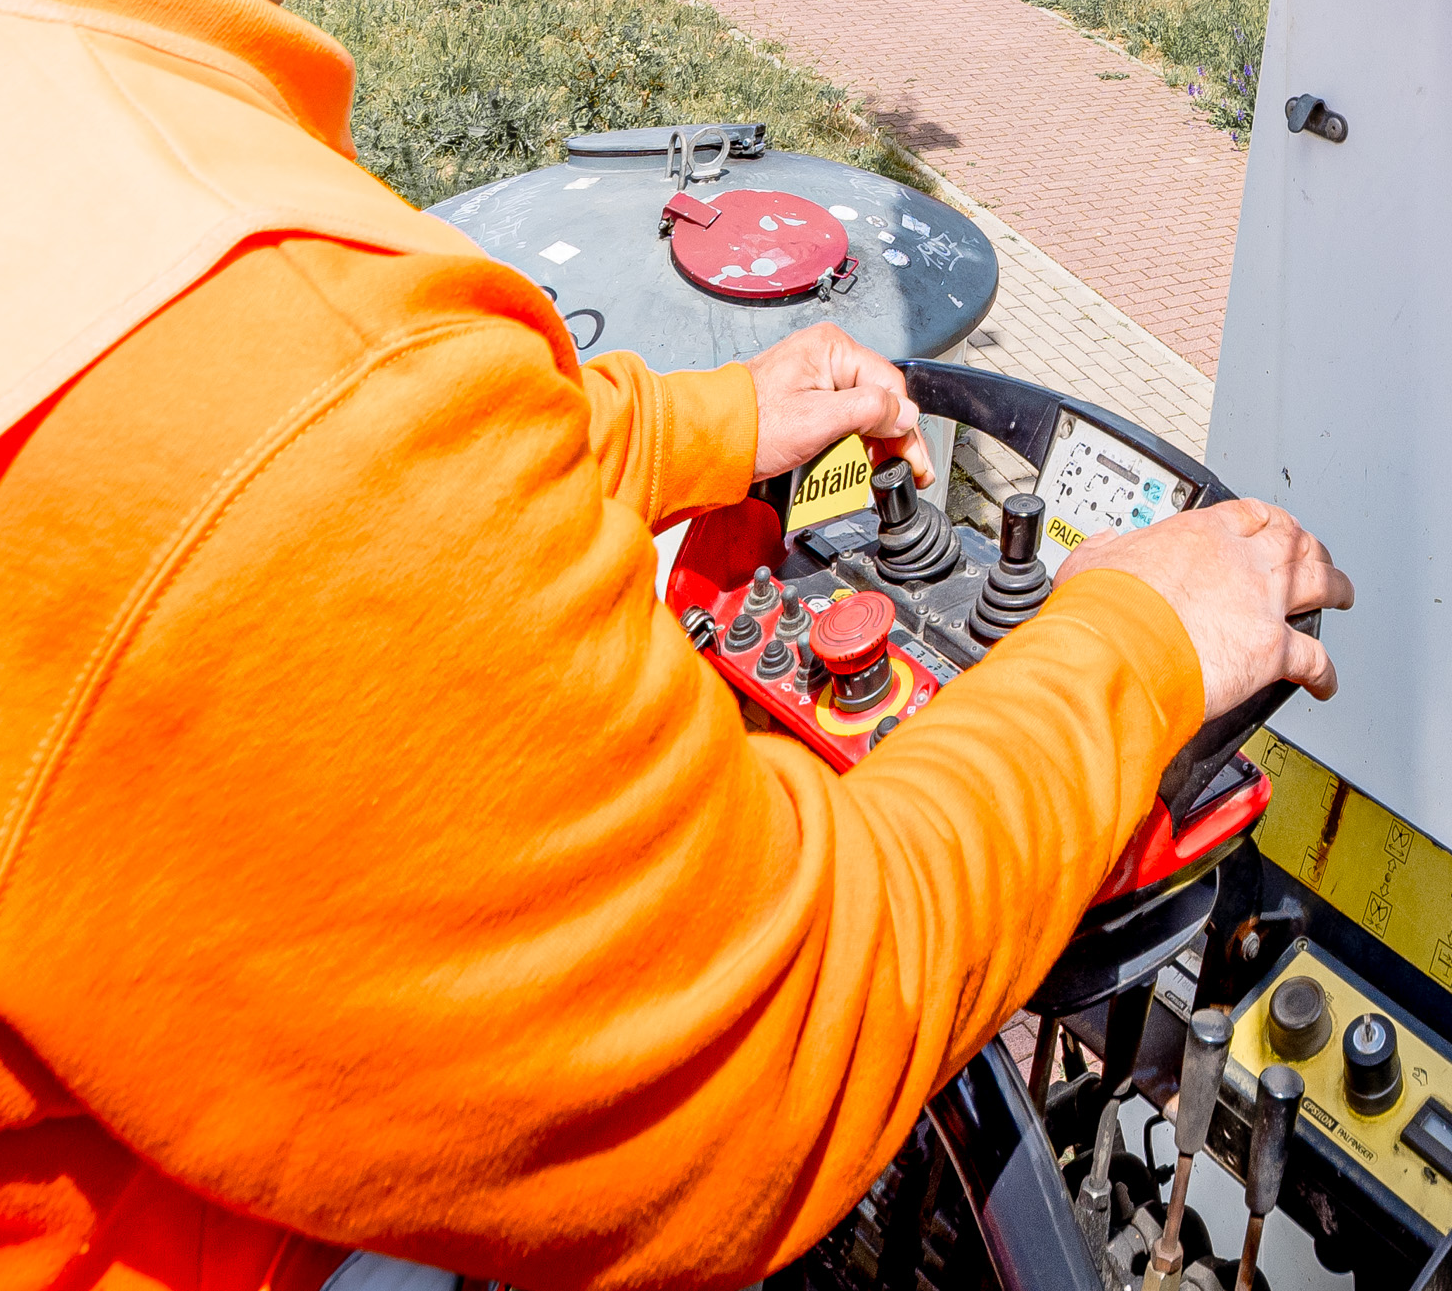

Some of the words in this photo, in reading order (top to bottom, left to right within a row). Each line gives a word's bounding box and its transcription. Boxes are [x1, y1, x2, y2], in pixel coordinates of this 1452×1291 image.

[793, 460, 867, 507] abfälle
[1303, 1099, 1336, 1129] EPSILON
[1336, 1127, 1375, 1162] PALFINGER
